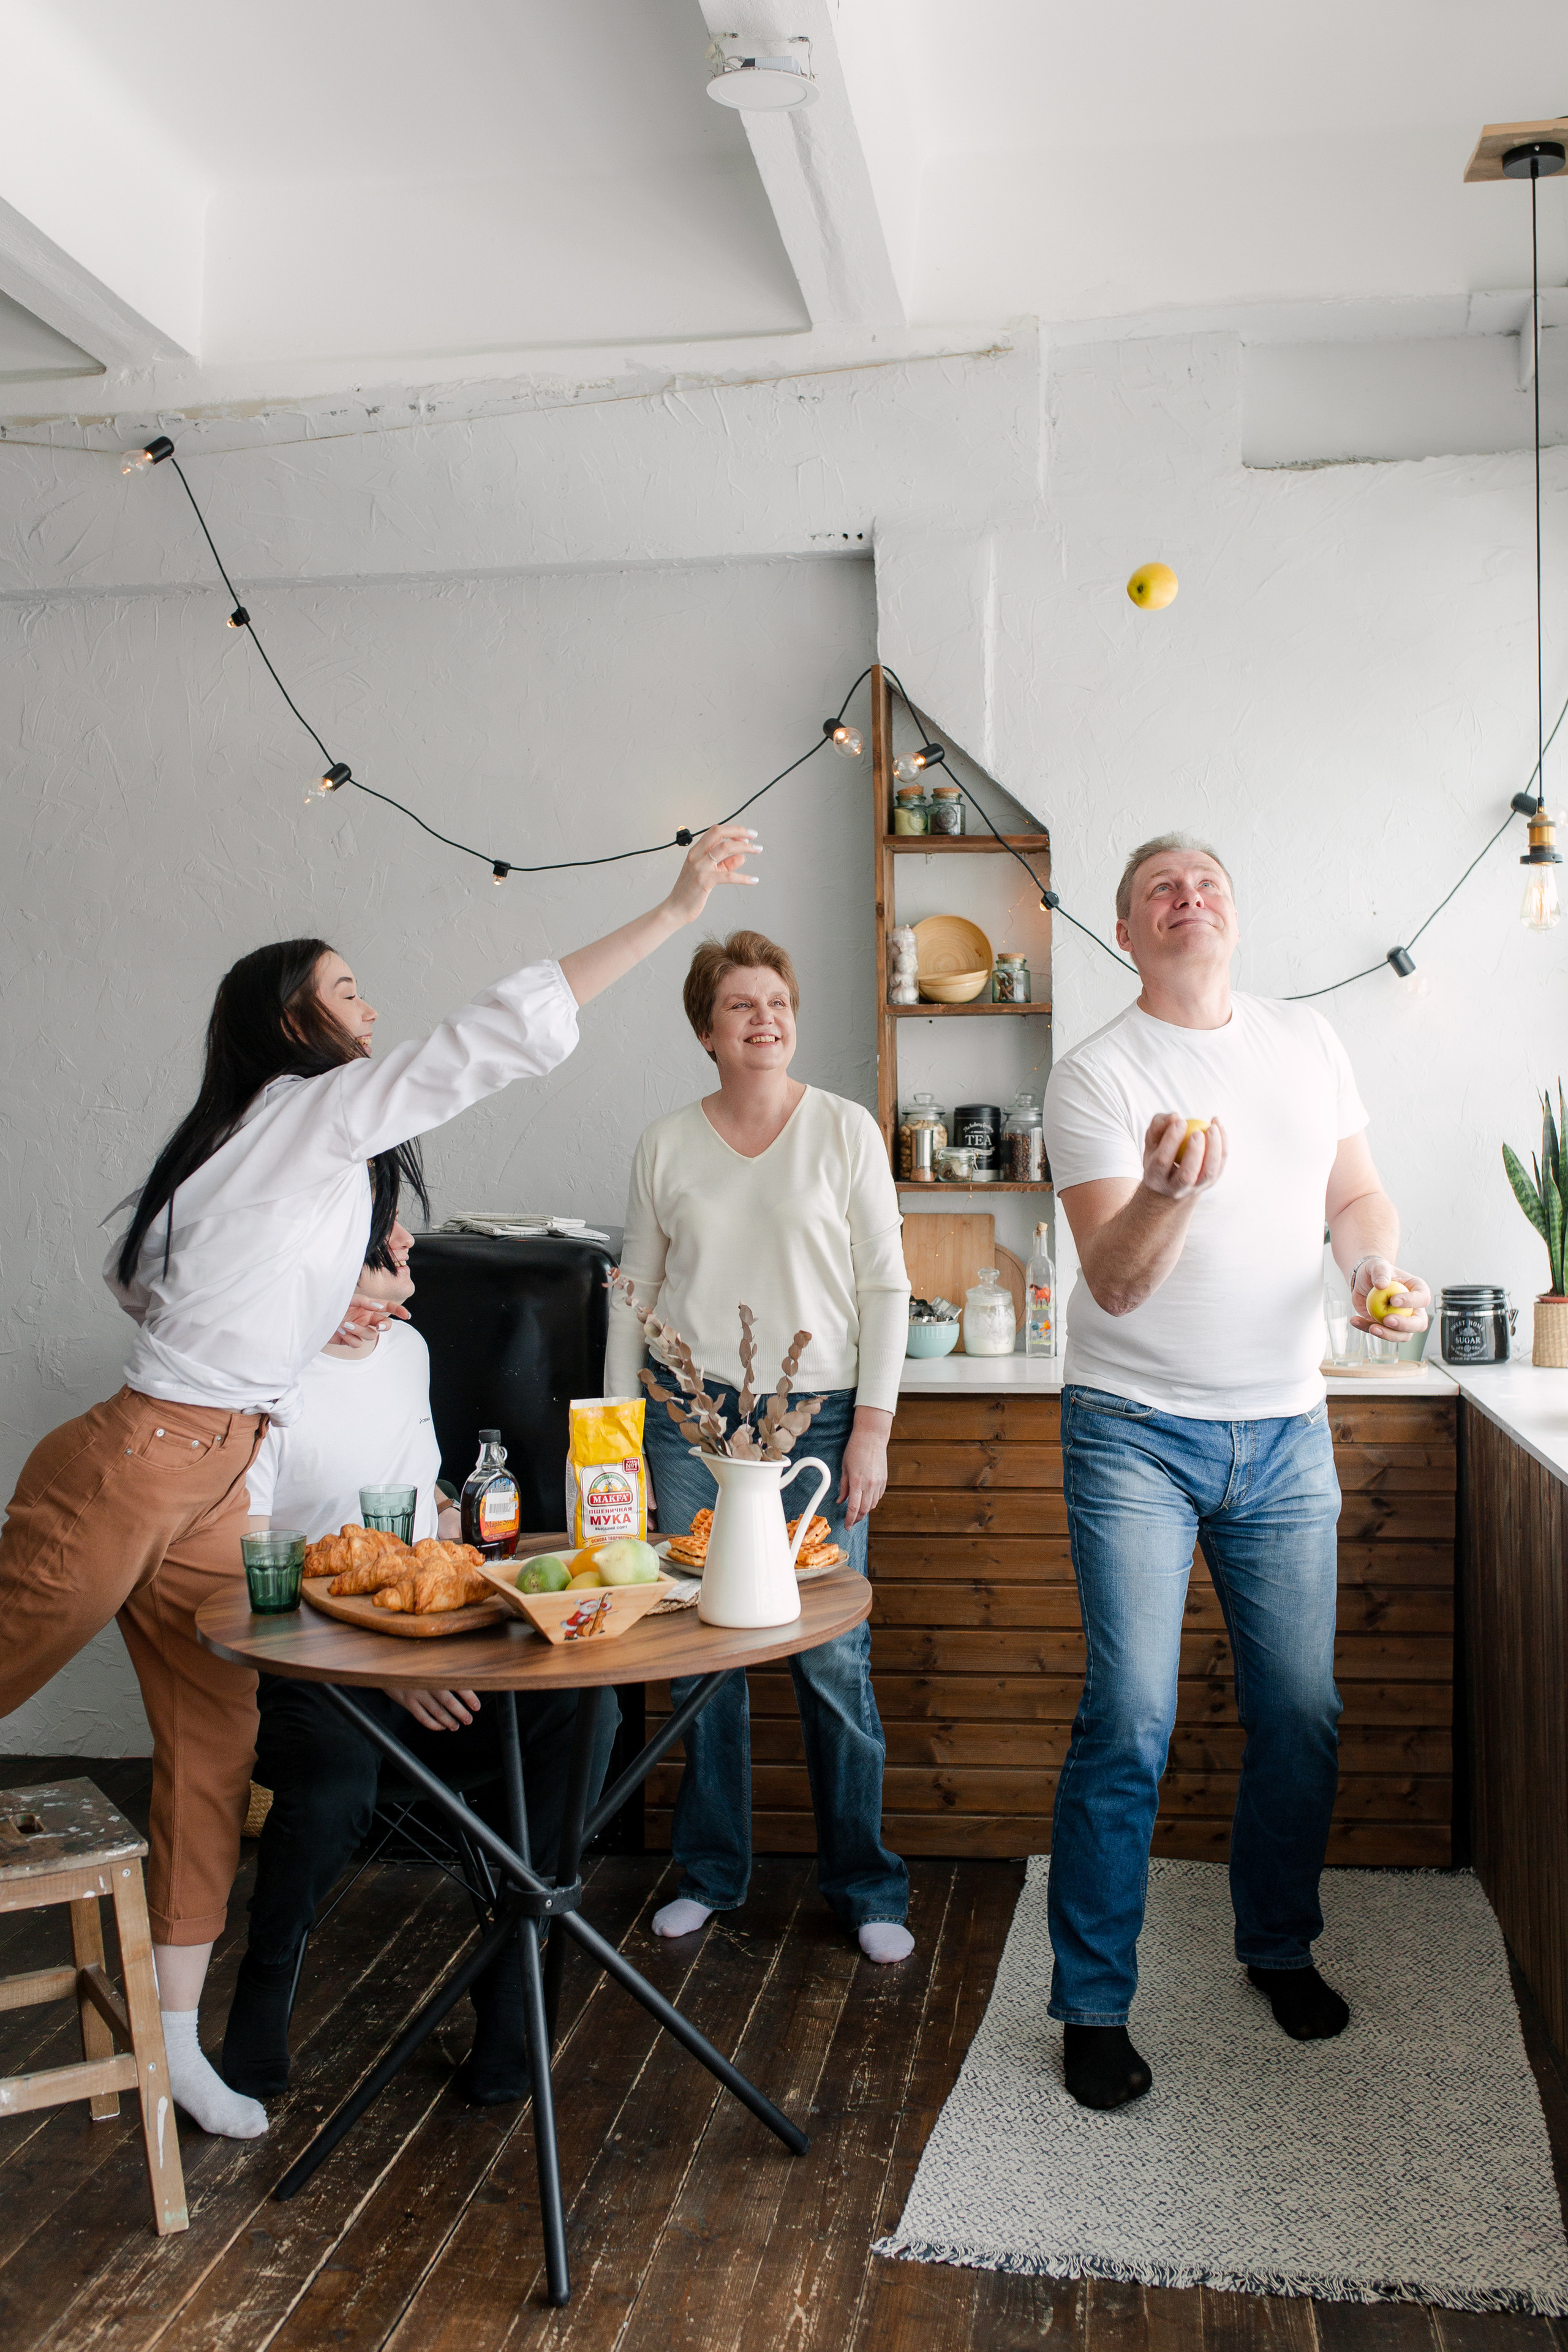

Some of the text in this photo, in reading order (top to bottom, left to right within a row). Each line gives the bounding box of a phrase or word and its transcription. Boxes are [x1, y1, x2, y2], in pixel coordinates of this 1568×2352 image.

[965, 1134, 992, 1145] TEA
[593, 1494, 628, 1504] MAKFA
[590, 1513, 631, 1525] МУКА
[485, 1520, 502, 1529] Maple
